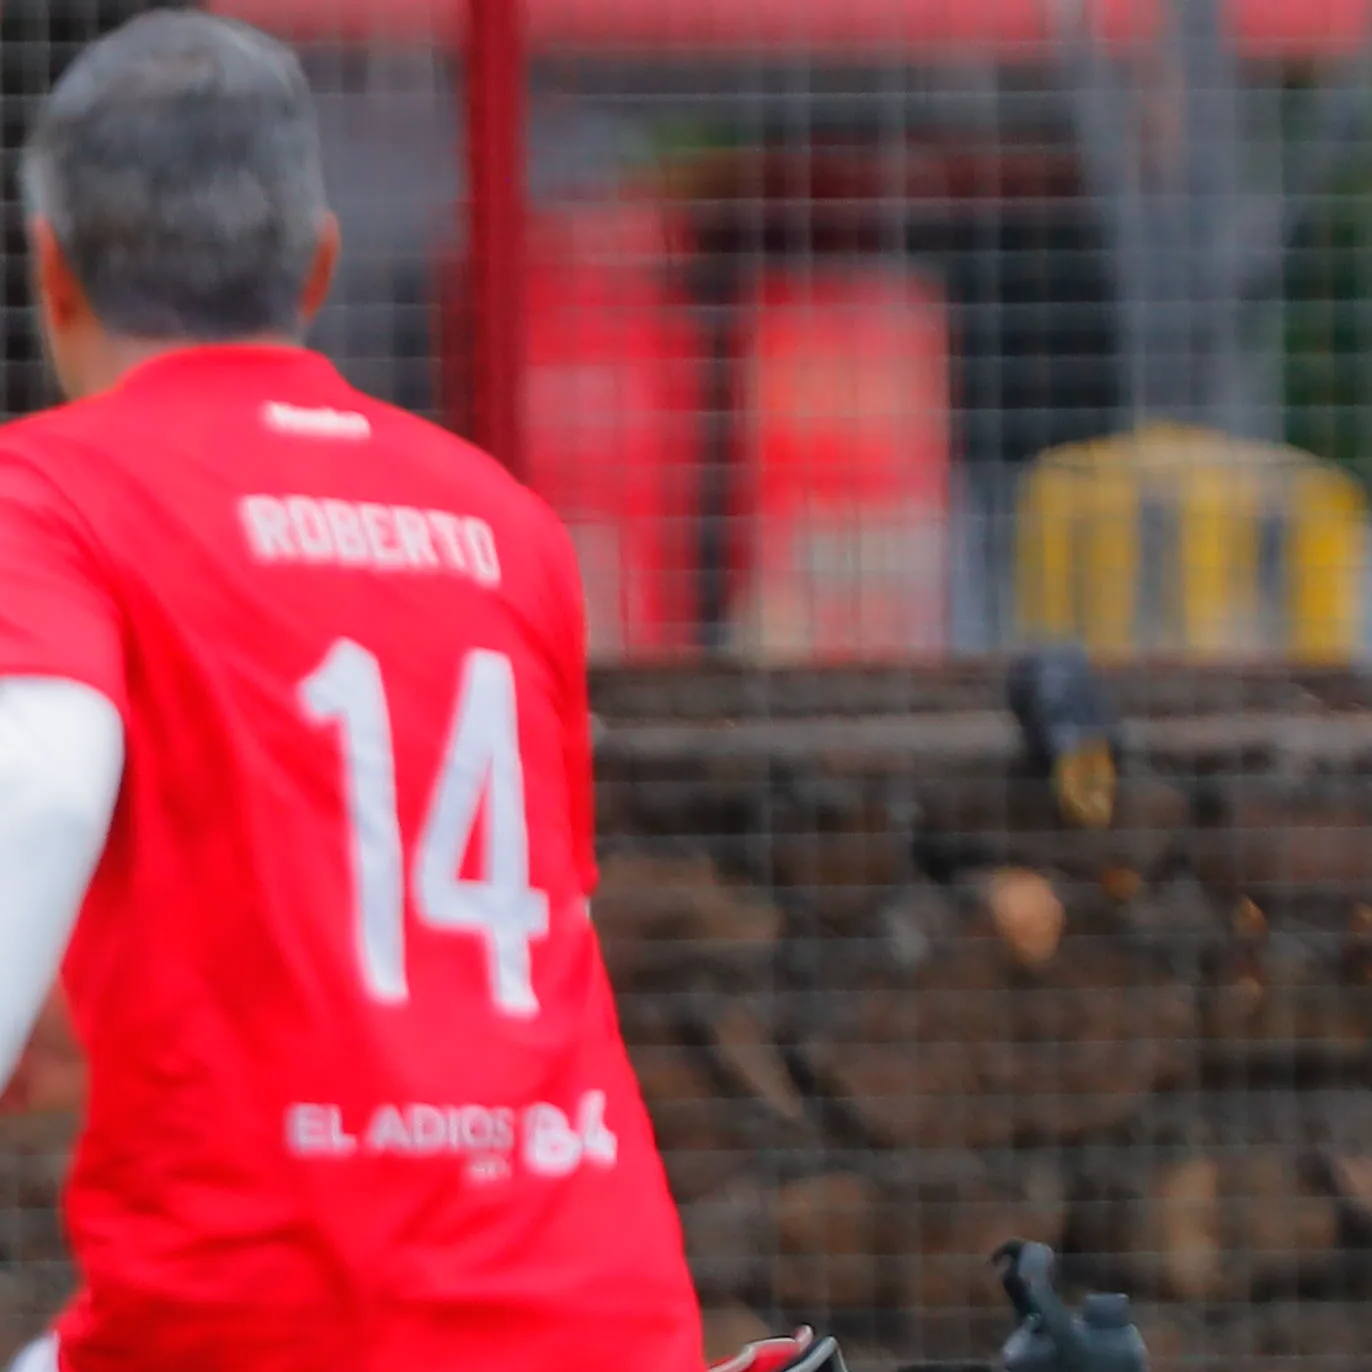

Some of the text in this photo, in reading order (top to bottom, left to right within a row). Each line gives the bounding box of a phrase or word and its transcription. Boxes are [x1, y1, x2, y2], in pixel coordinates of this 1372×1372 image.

[244, 496, 500, 585] ROBERTO
[300, 637, 549, 1019] 14
[287, 1103, 357, 1152] EL
